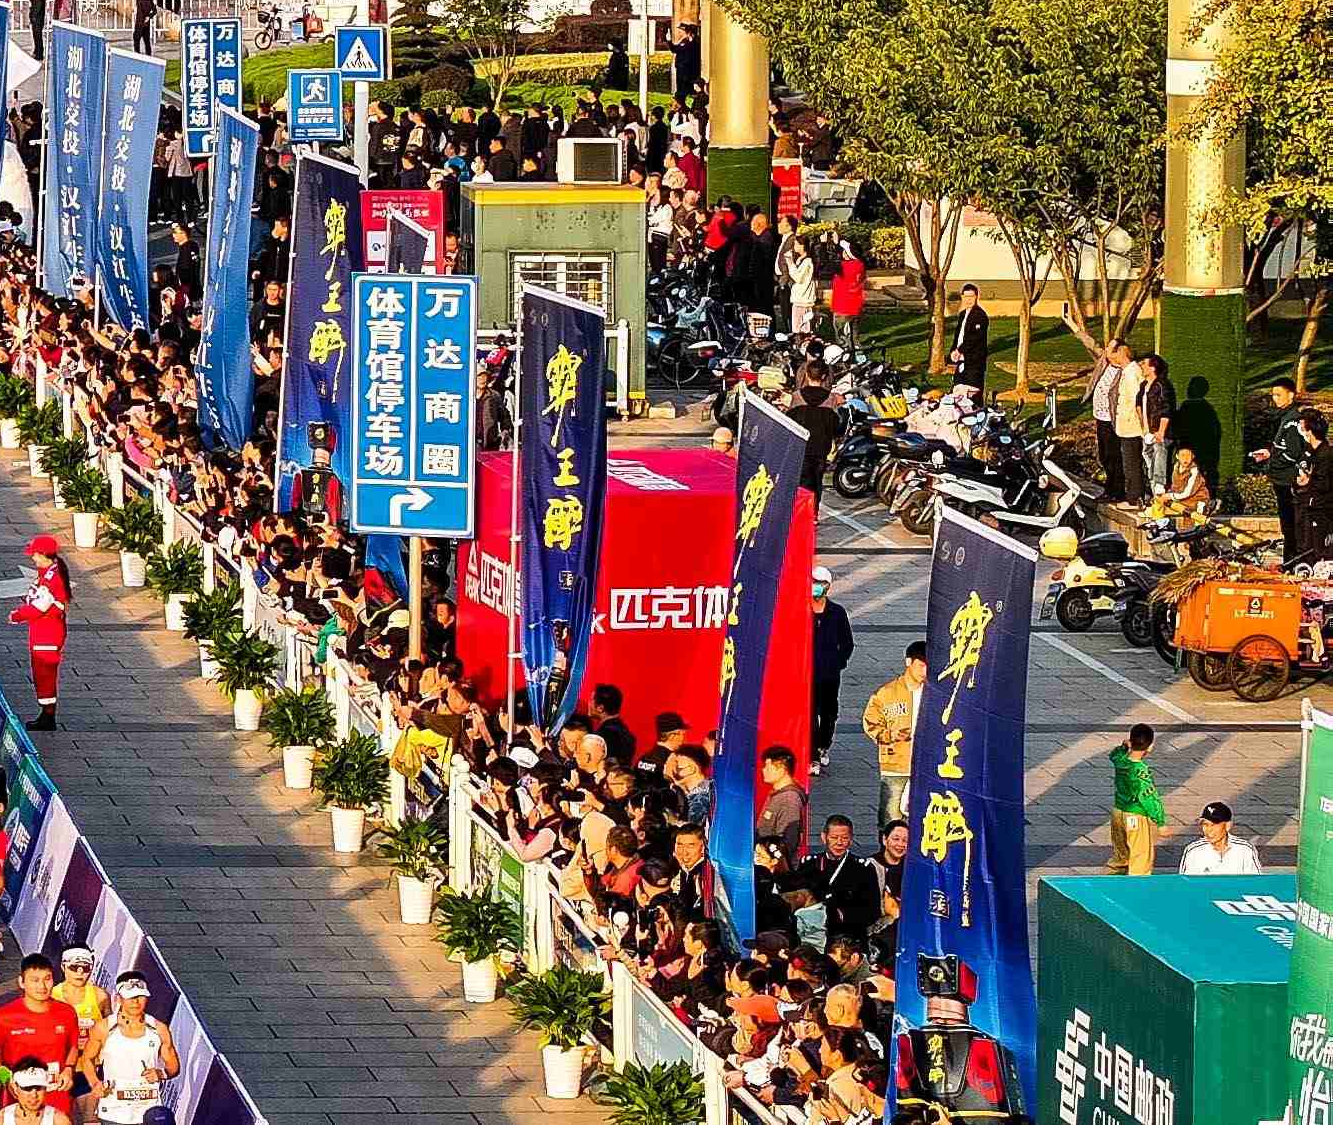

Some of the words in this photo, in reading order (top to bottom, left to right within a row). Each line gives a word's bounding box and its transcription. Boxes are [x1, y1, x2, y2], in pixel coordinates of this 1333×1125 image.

[187, 25, 209, 126] 体育馆停车场
[215, 25, 237, 109] 万达商
[365, 287, 406, 476] 体育馆停车场
[422, 288, 464, 477] 万达商圈
